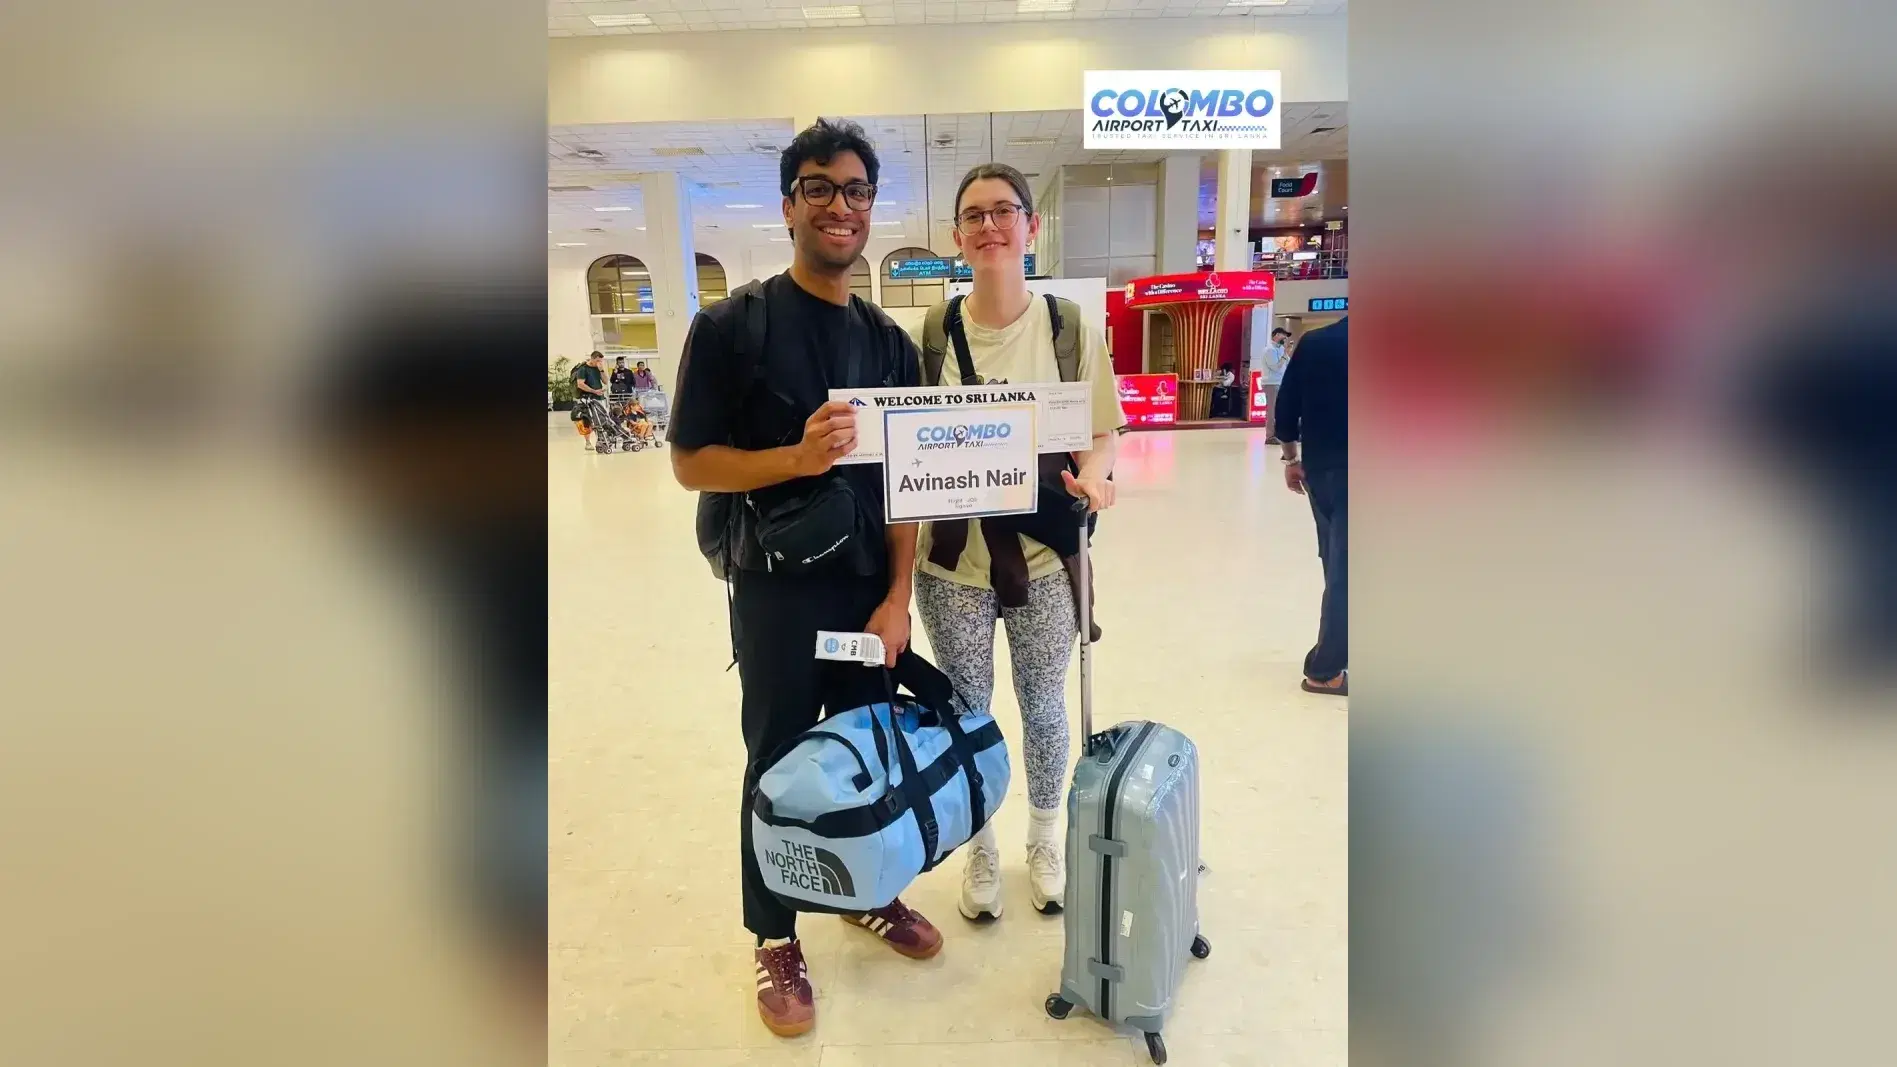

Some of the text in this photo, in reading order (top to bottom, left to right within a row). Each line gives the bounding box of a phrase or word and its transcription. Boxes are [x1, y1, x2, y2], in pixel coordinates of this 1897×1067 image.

[873, 391, 1036, 407] WELCOME TO SRI LANKA
[916, 422, 1011, 443] COLOMBO
[917, 440, 984, 451] AIRPORT TAXI
[898, 467, 1027, 493] Avinash Nair
[802, 533, 850, 565] Champion
[850, 639, 858, 656] CMB
[764, 848, 820, 876] NORTH
[781, 839, 815, 862] THE
[780, 868, 822, 893] FACE
